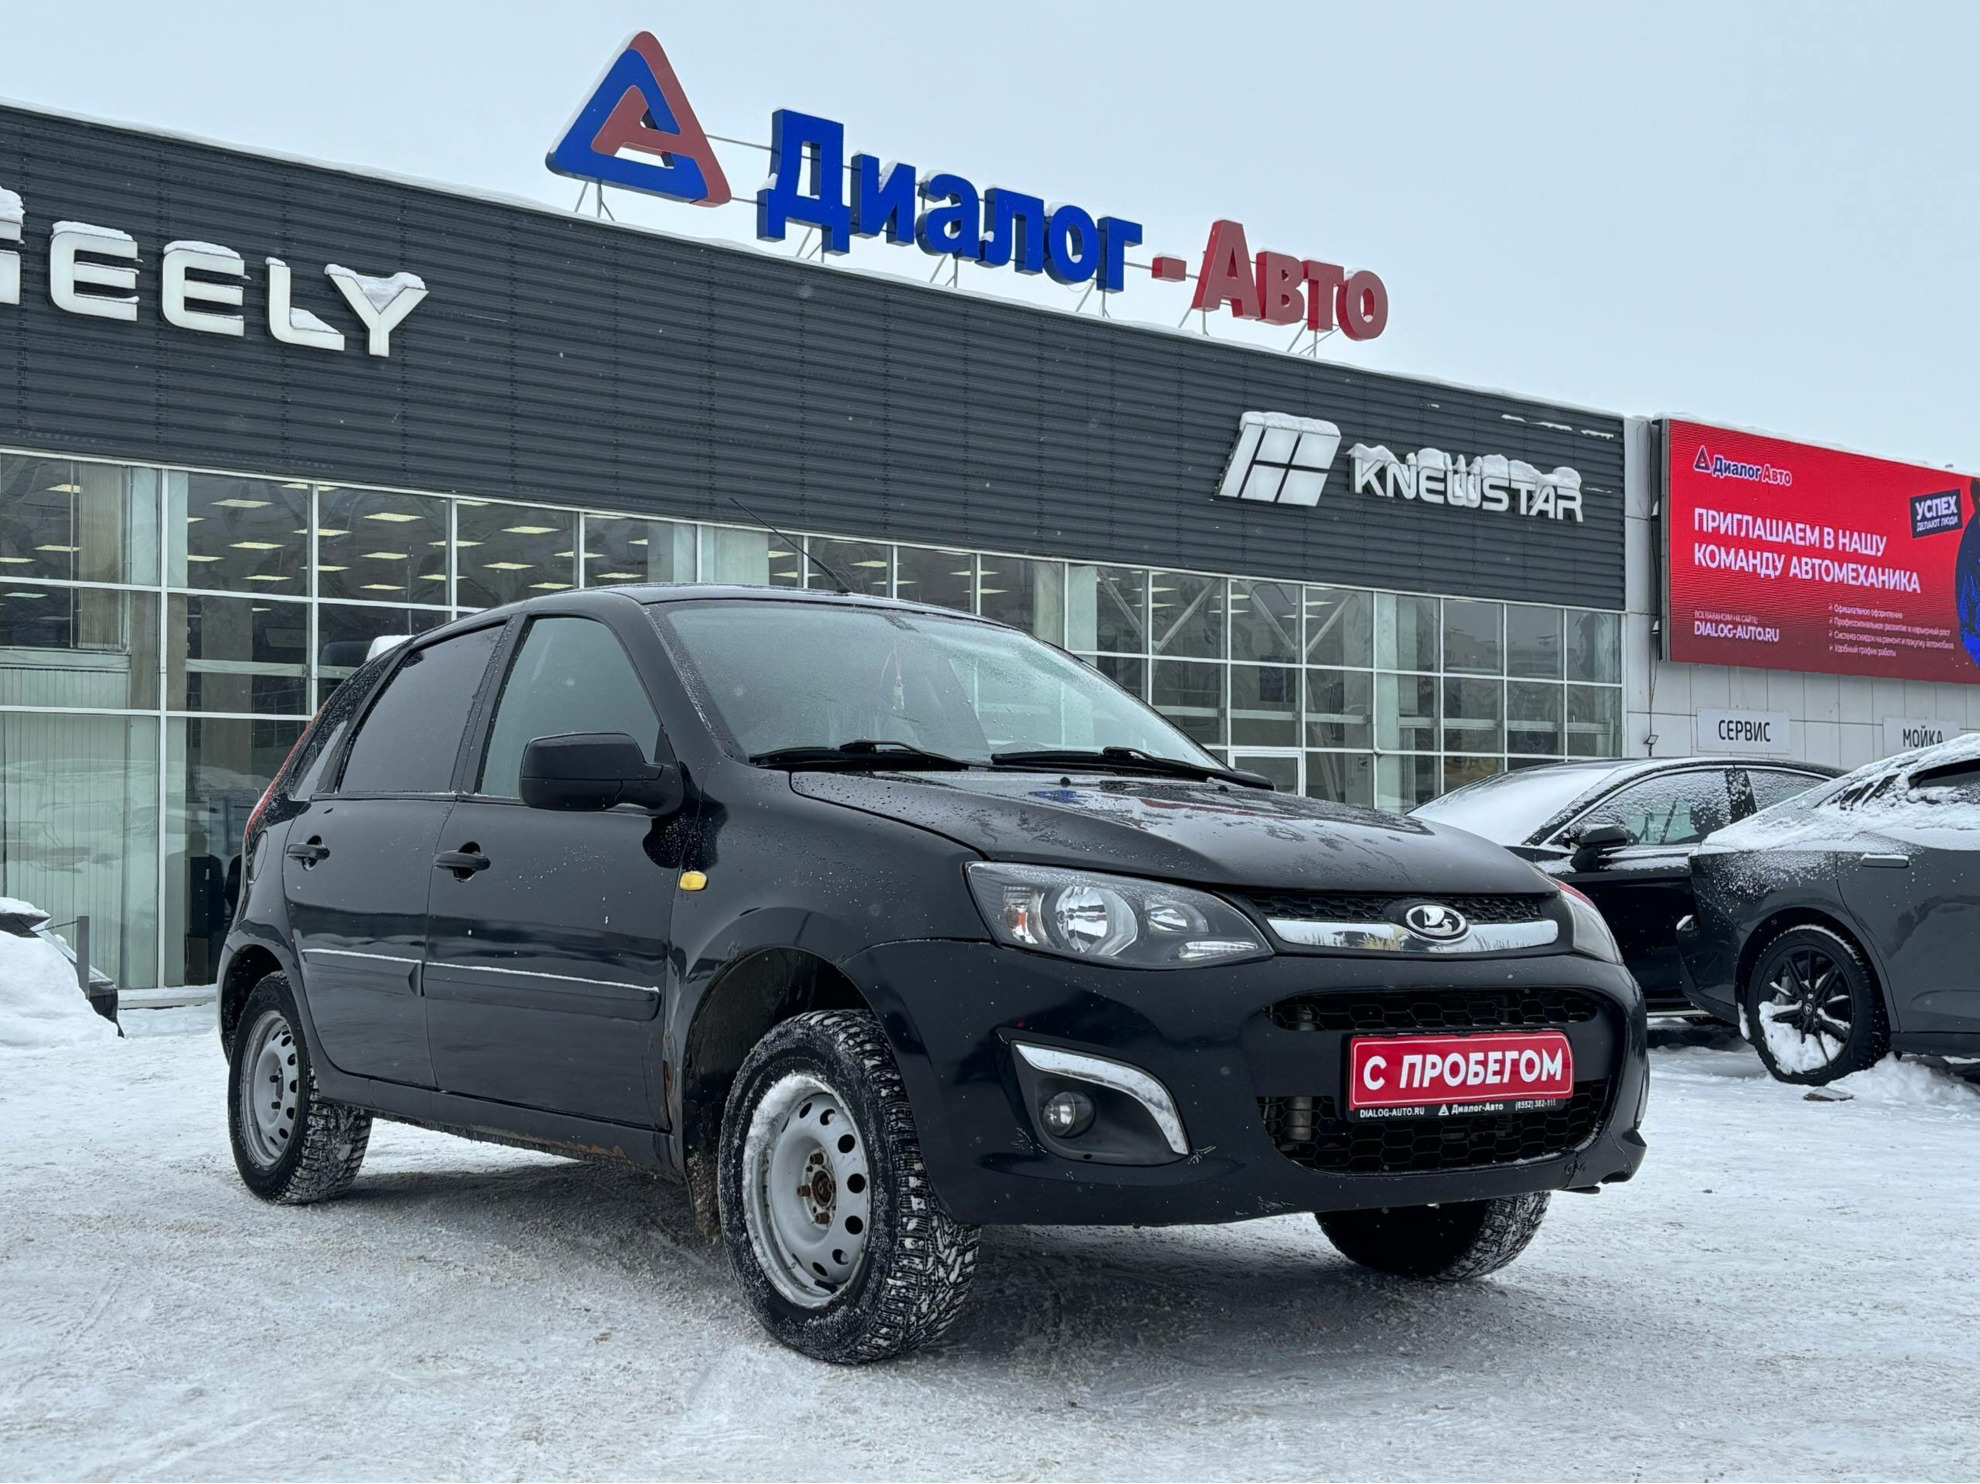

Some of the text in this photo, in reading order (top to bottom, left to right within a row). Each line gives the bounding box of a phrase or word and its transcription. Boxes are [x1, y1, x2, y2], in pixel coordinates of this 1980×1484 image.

[0, 218, 428, 357] EELY
[1350, 452, 1584, 522] KNEWSTAR
[1915, 495, 1957, 520] УСПЕХ
[1694, 507, 1887, 557] ПРИГЛАШАЕМ В НАШУ
[1694, 543, 1921, 593] КОМАНДУ АВТОМЕХАНИКА
[1694, 621, 1779, 642] DIALOG-AUTO.RU
[1718, 719, 1771, 742] СЕРВИС
[1903, 724, 1943, 748] МОЙКА
[1363, 1048, 1563, 1090] С ПРОБЕГОМ
[1360, 1107, 1425, 1118] DIALOG-AUTO.RU
[1451, 1102, 1504, 1115] Диалог-Авто
